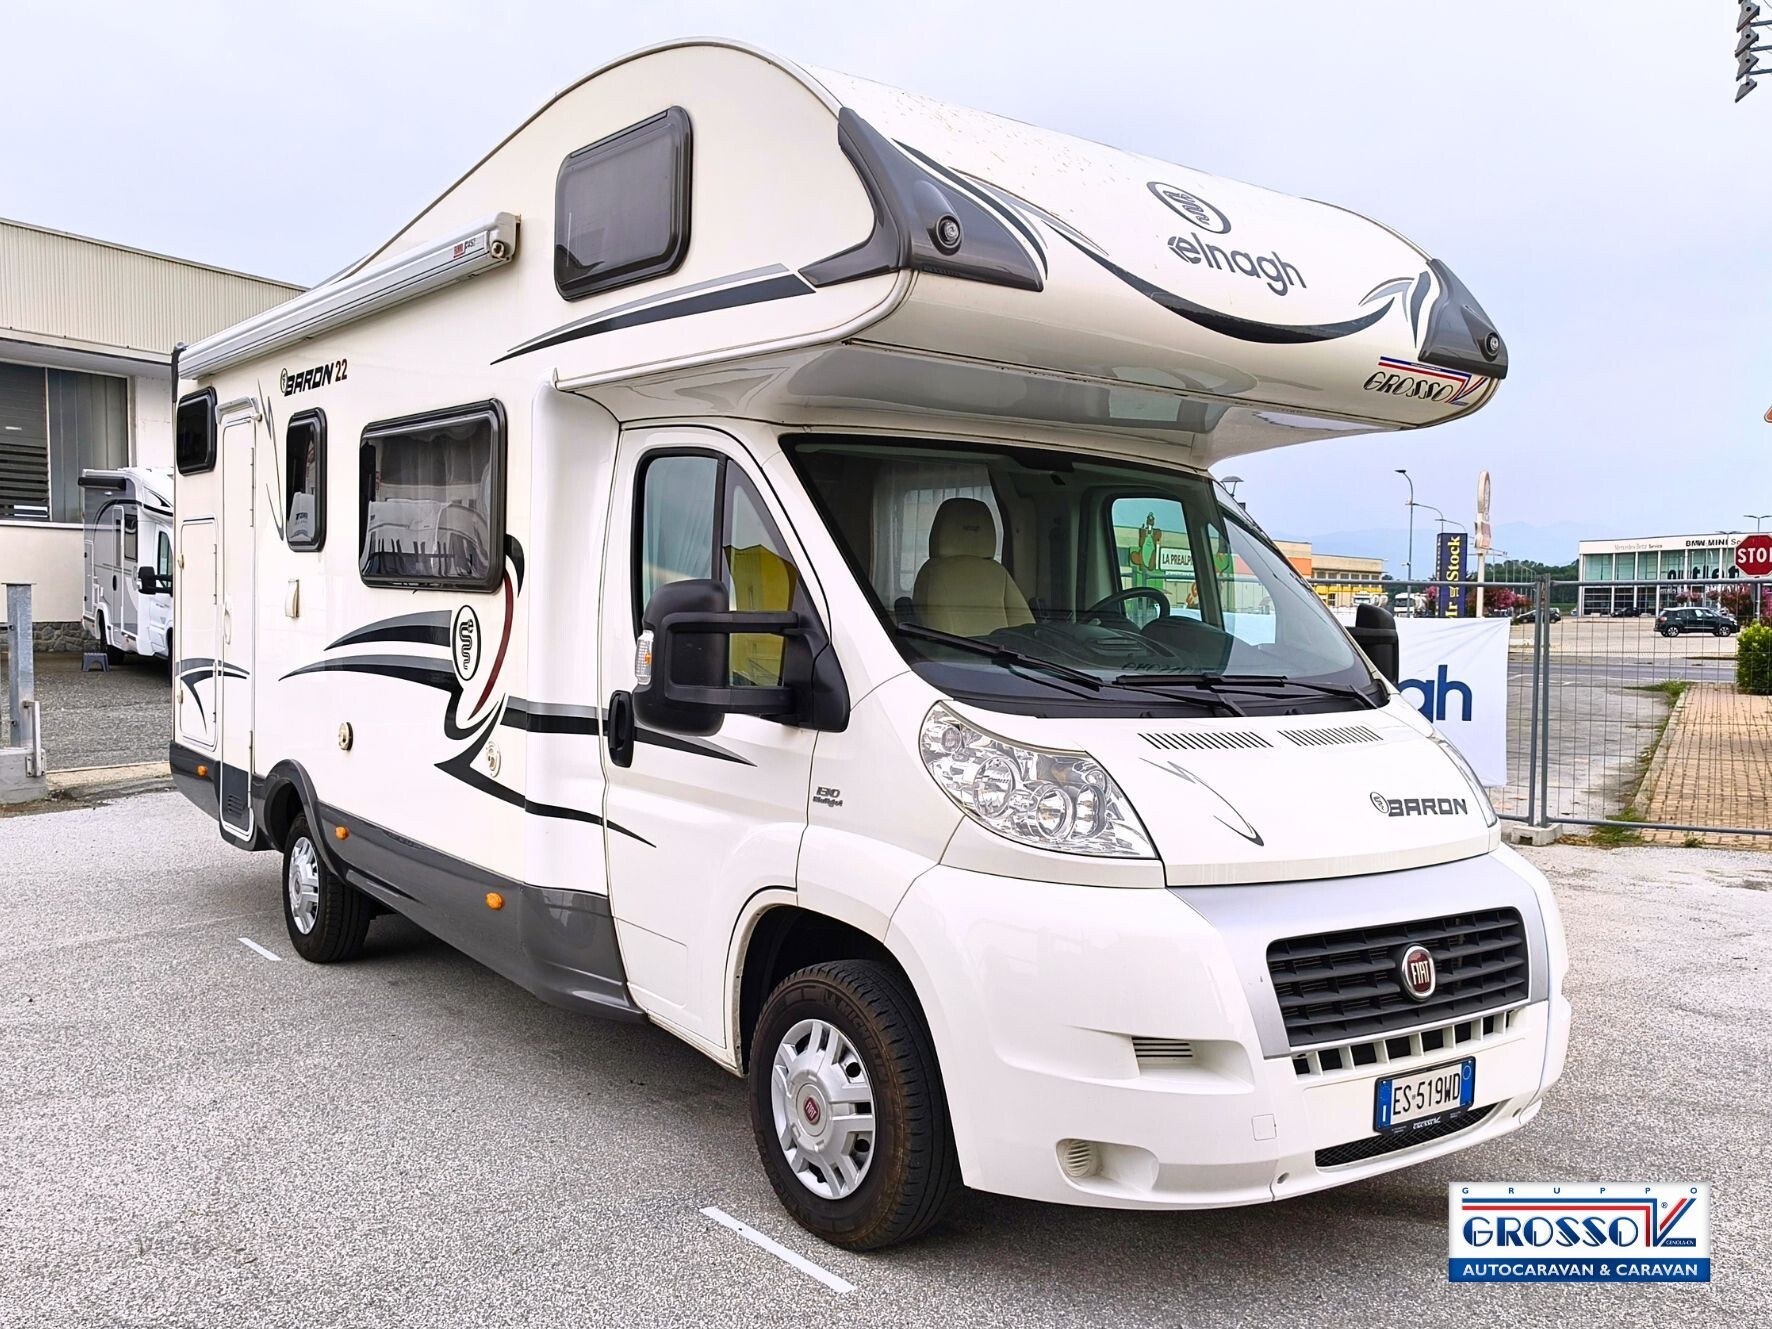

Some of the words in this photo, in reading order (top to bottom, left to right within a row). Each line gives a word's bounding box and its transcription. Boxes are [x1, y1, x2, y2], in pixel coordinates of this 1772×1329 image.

[1167, 232, 1307, 296] elnagh
[284, 362, 334, 397] BARON
[335, 358, 348, 382] 22
[1363, 371, 1454, 402] GROSSO
[1685, 539, 1705, 547] BMW
[1162, 553, 1170, 565] LA
[1446, 536, 1461, 582] Stock
[1387, 798, 1468, 817] BARON
[1410, 960, 1430, 985] FIAT
